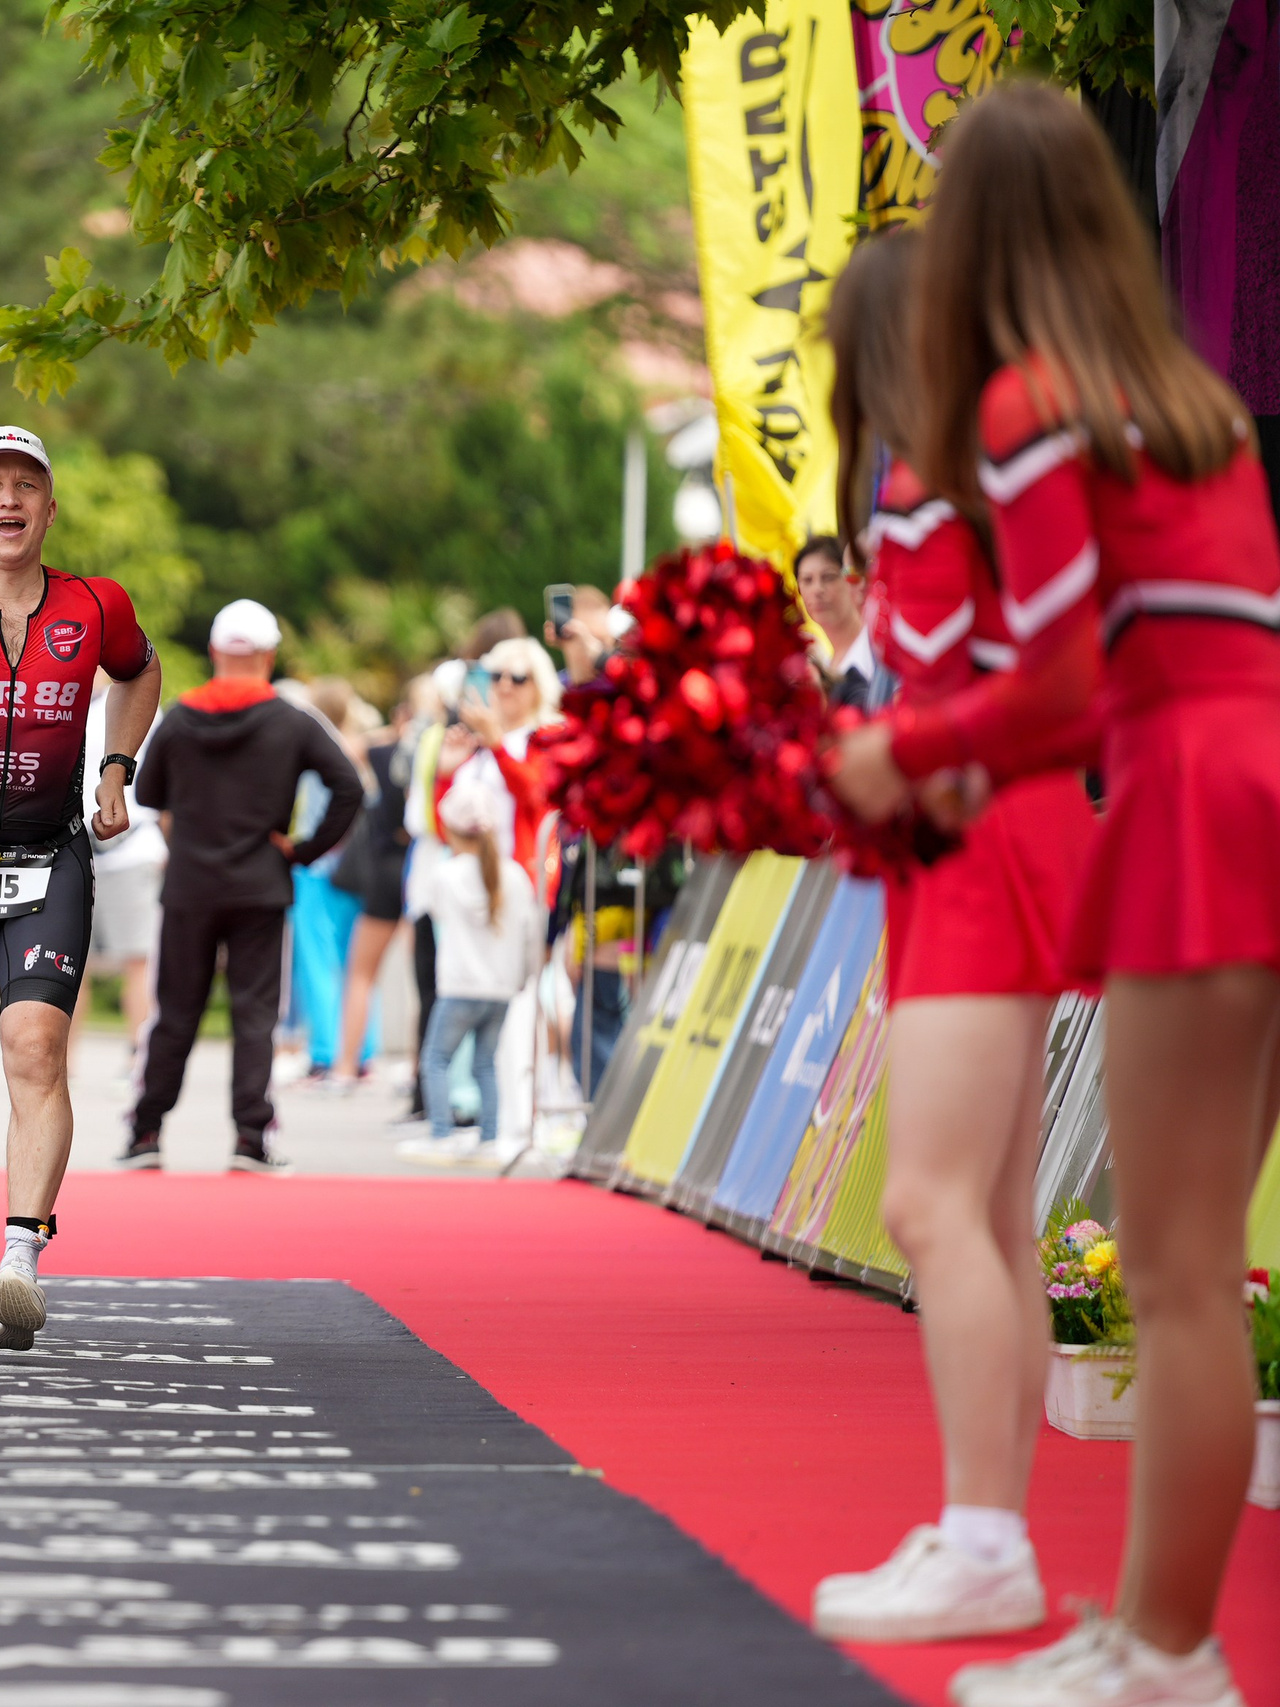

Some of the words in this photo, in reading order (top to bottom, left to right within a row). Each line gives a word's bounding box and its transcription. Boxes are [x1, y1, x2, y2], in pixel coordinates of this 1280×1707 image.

[53, 627, 74, 636] SBR
[59, 645, 71, 653] 88
[34, 681, 80, 707] 88
[33, 709, 72, 721] TEAM
[12, 785, 36, 793] SERVICES
